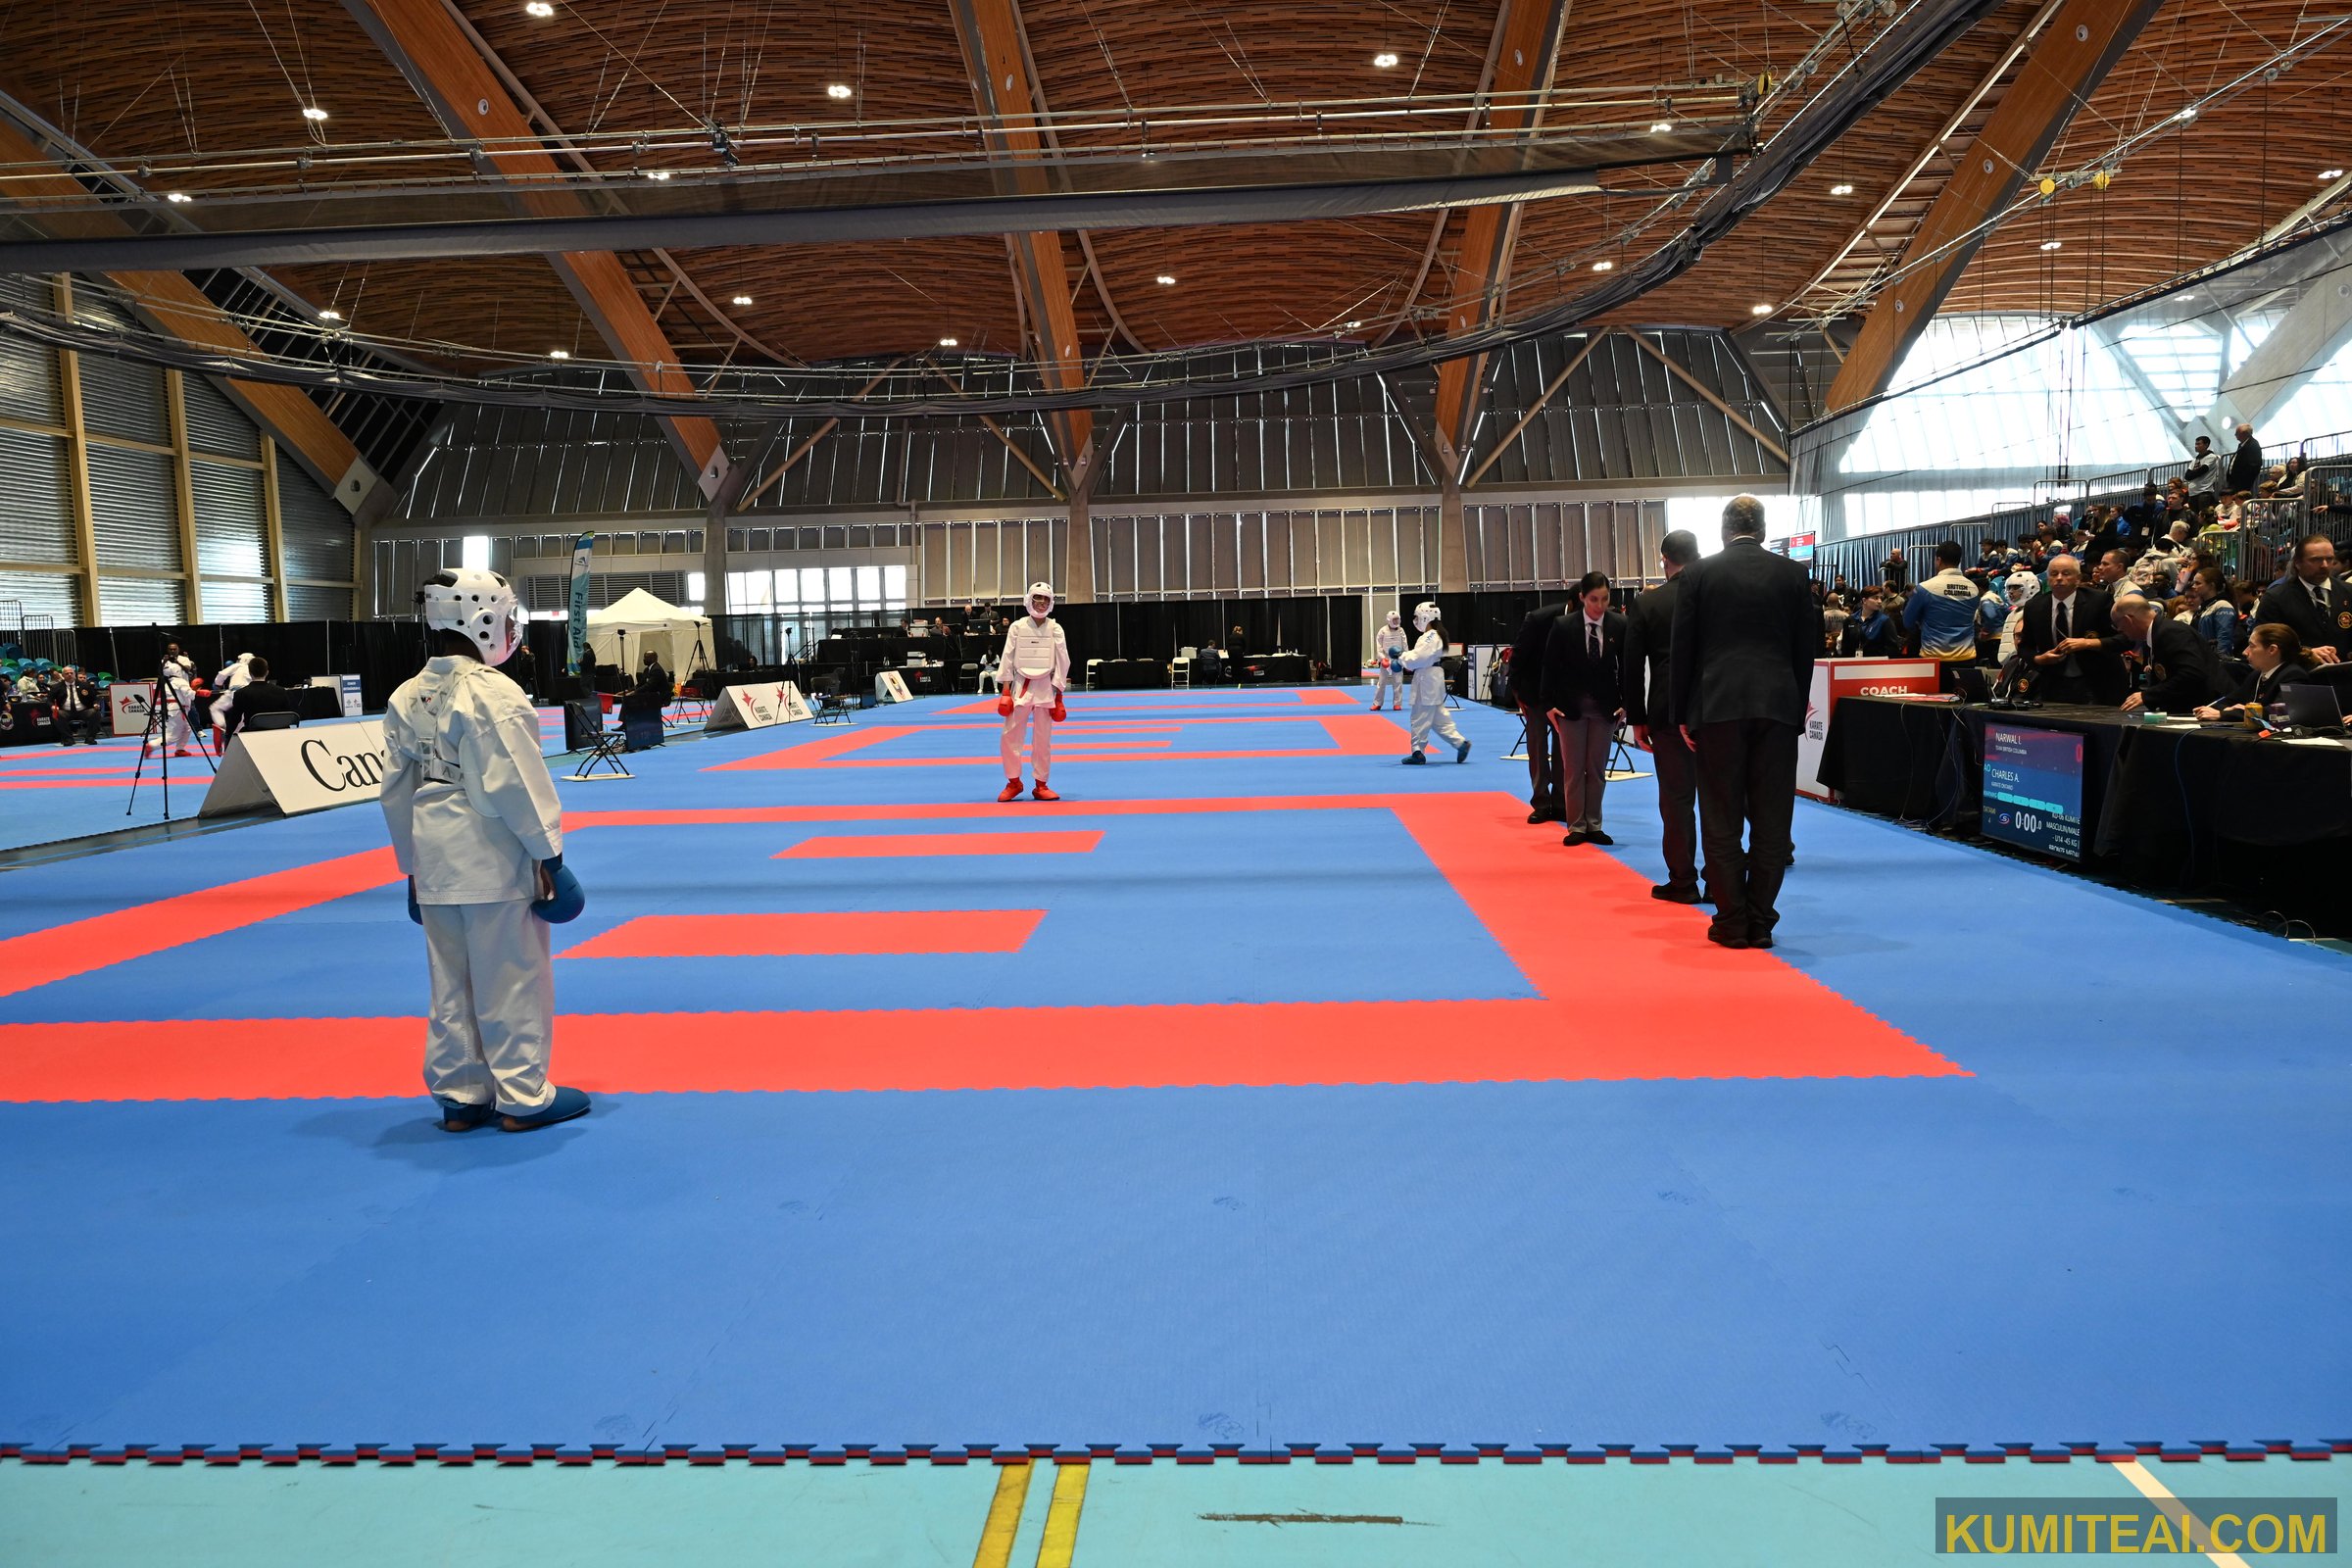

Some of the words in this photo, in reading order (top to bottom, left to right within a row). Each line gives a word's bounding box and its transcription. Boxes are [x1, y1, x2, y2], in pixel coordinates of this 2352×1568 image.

[572, 592, 583, 624] First
[572, 626, 582, 649] Aid
[1860, 685, 1908, 696] COACH
[1809, 720, 1823, 731] KARATE
[1809, 730, 1824, 741] CANADA
[1995, 733, 2018, 744] NARWAL
[301, 738, 385, 792] Can
[1991, 768, 2014, 781] CHARLES
[2046, 821, 2081, 837] MASCULIN/MALE
